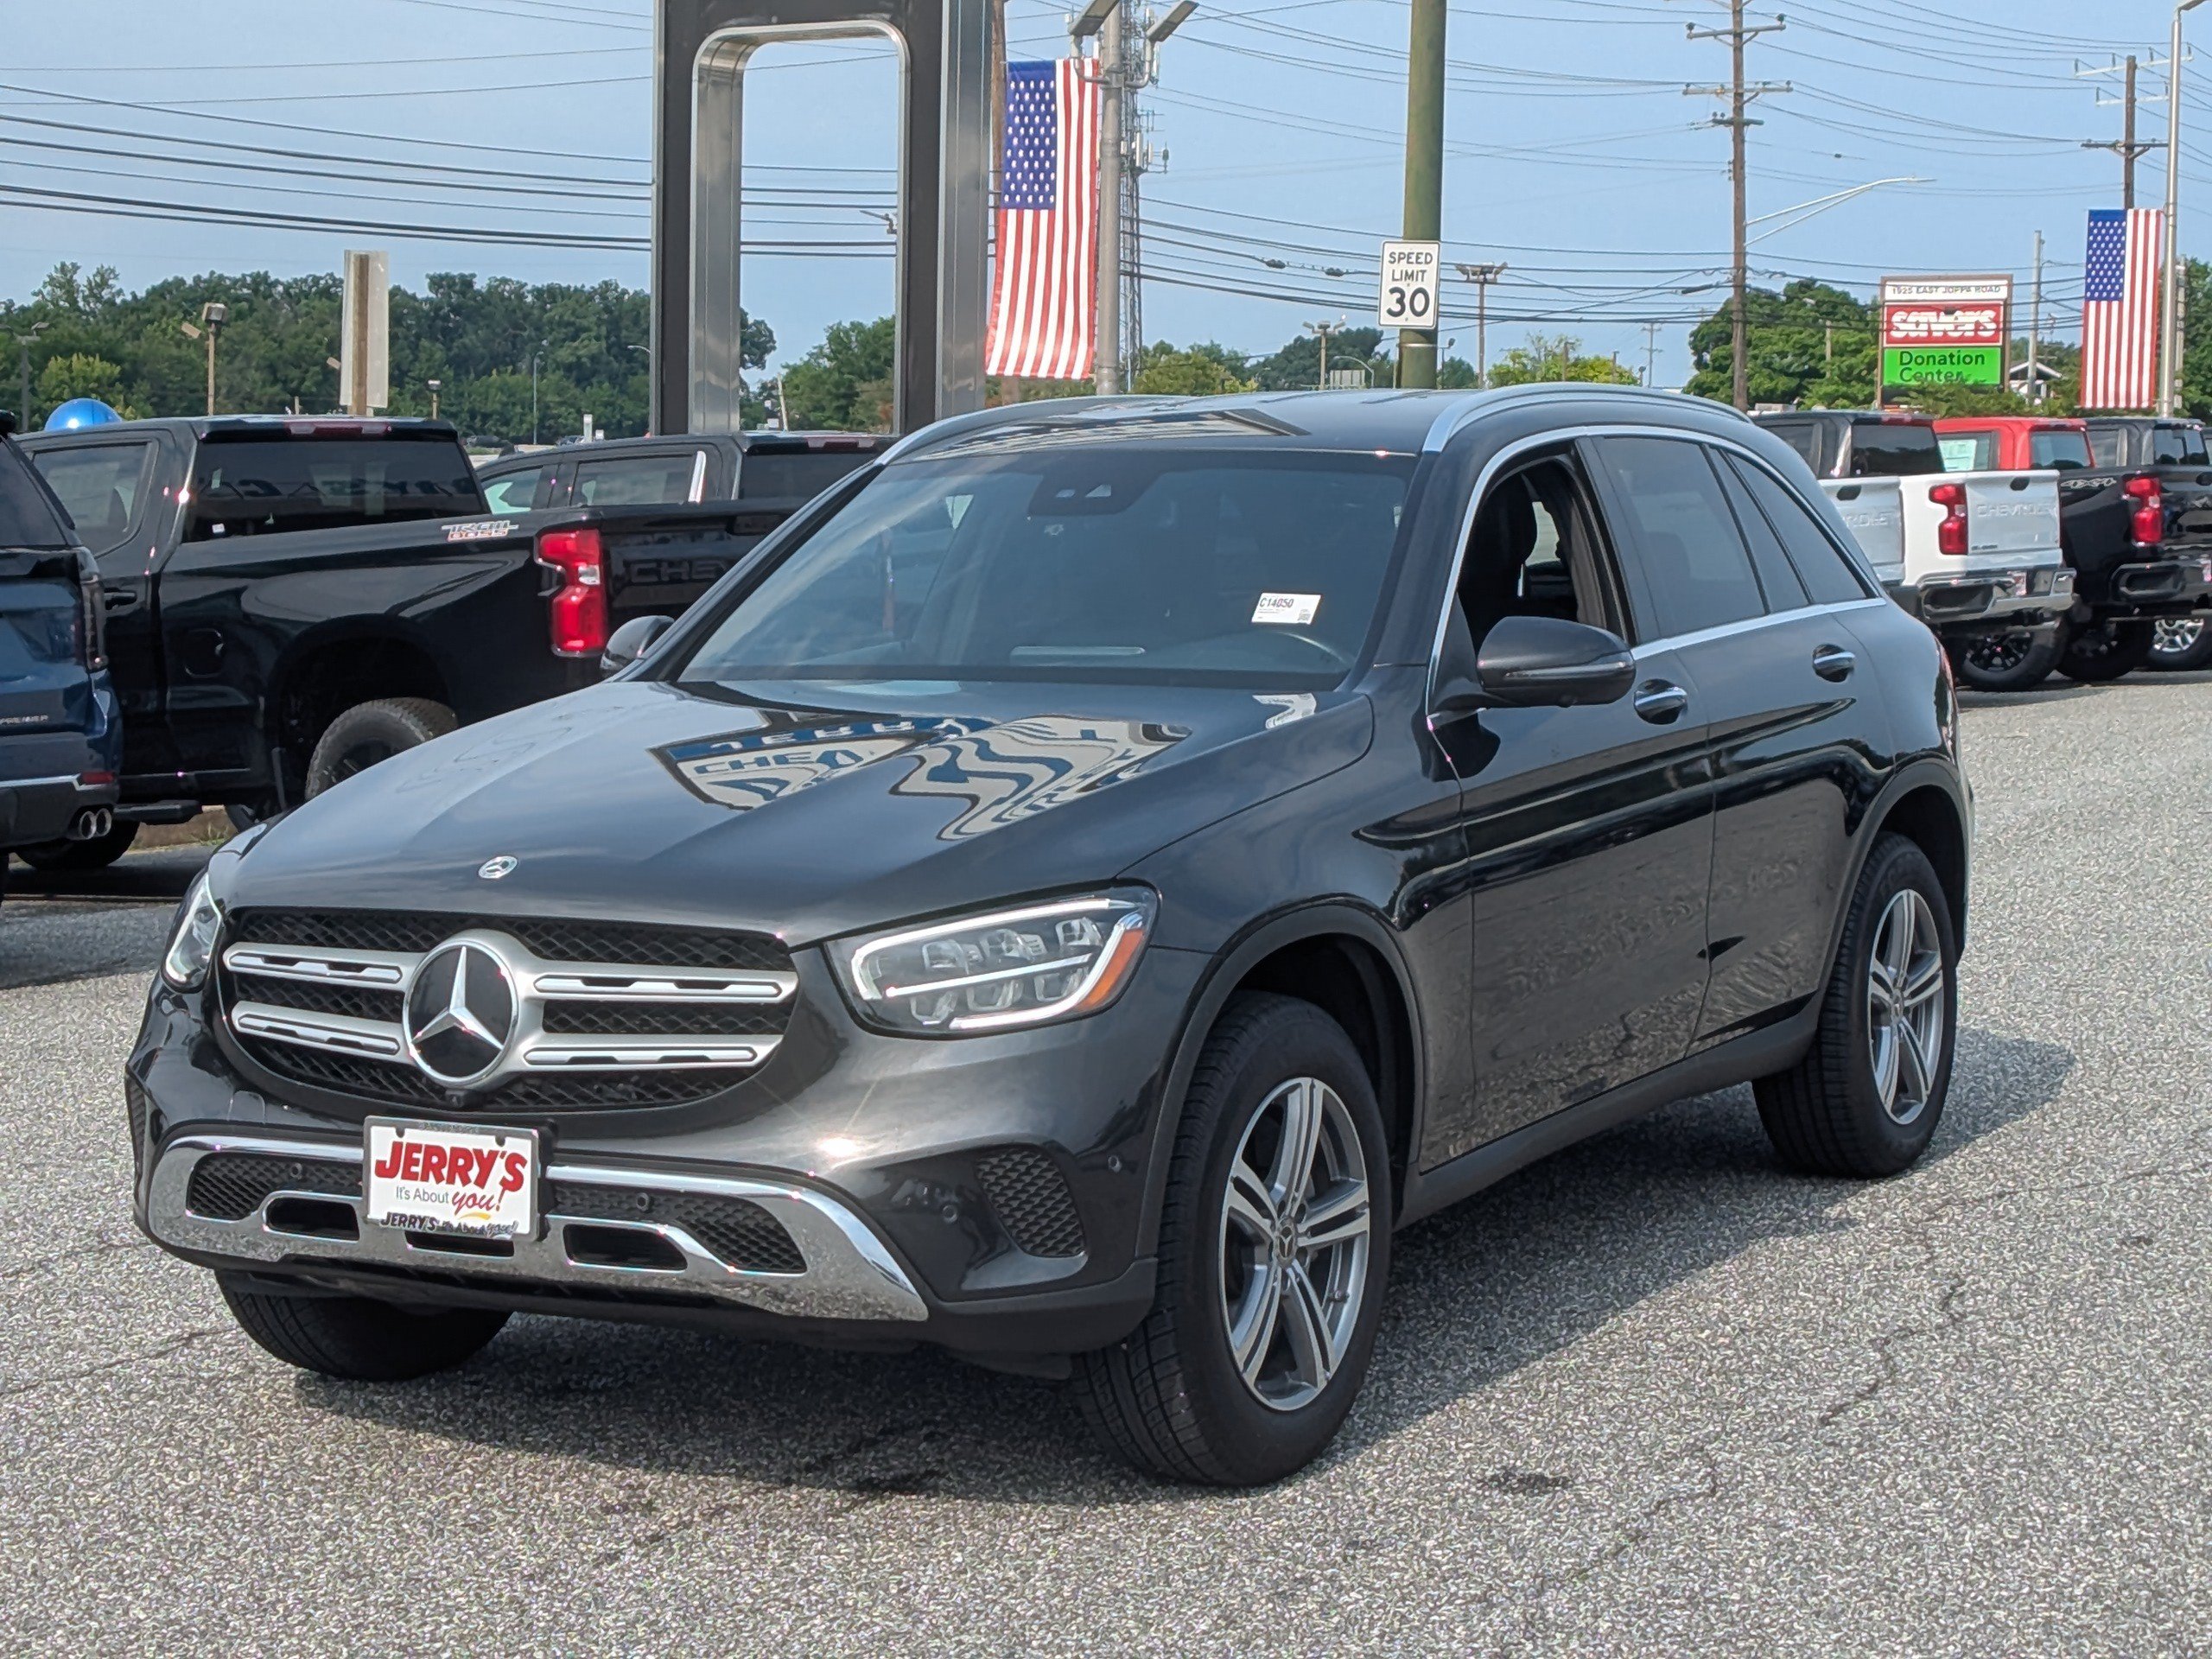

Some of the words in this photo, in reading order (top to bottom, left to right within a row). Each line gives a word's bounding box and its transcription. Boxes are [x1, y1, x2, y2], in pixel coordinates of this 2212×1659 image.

[1388, 251, 1433, 264] SPEED
[1392, 269, 1427, 282] LIMIT
[1916, 285, 1939, 294] EAST
[1942, 285, 1972, 294] JOPPA
[1974, 284, 2001, 293] ROAD
[1386, 286, 1430, 317] 30
[1899, 349, 1986, 365] Donation
[1899, 367, 1965, 383] Center
[1259, 597, 1294, 608] C14050
[374, 1141, 528, 1192] JERRY'S
[396, 1185, 410, 1200] It's
[413, 1188, 449, 1204] About
[451, 1187, 505, 1216] you!
[379, 1211, 440, 1230] JERRY'S
